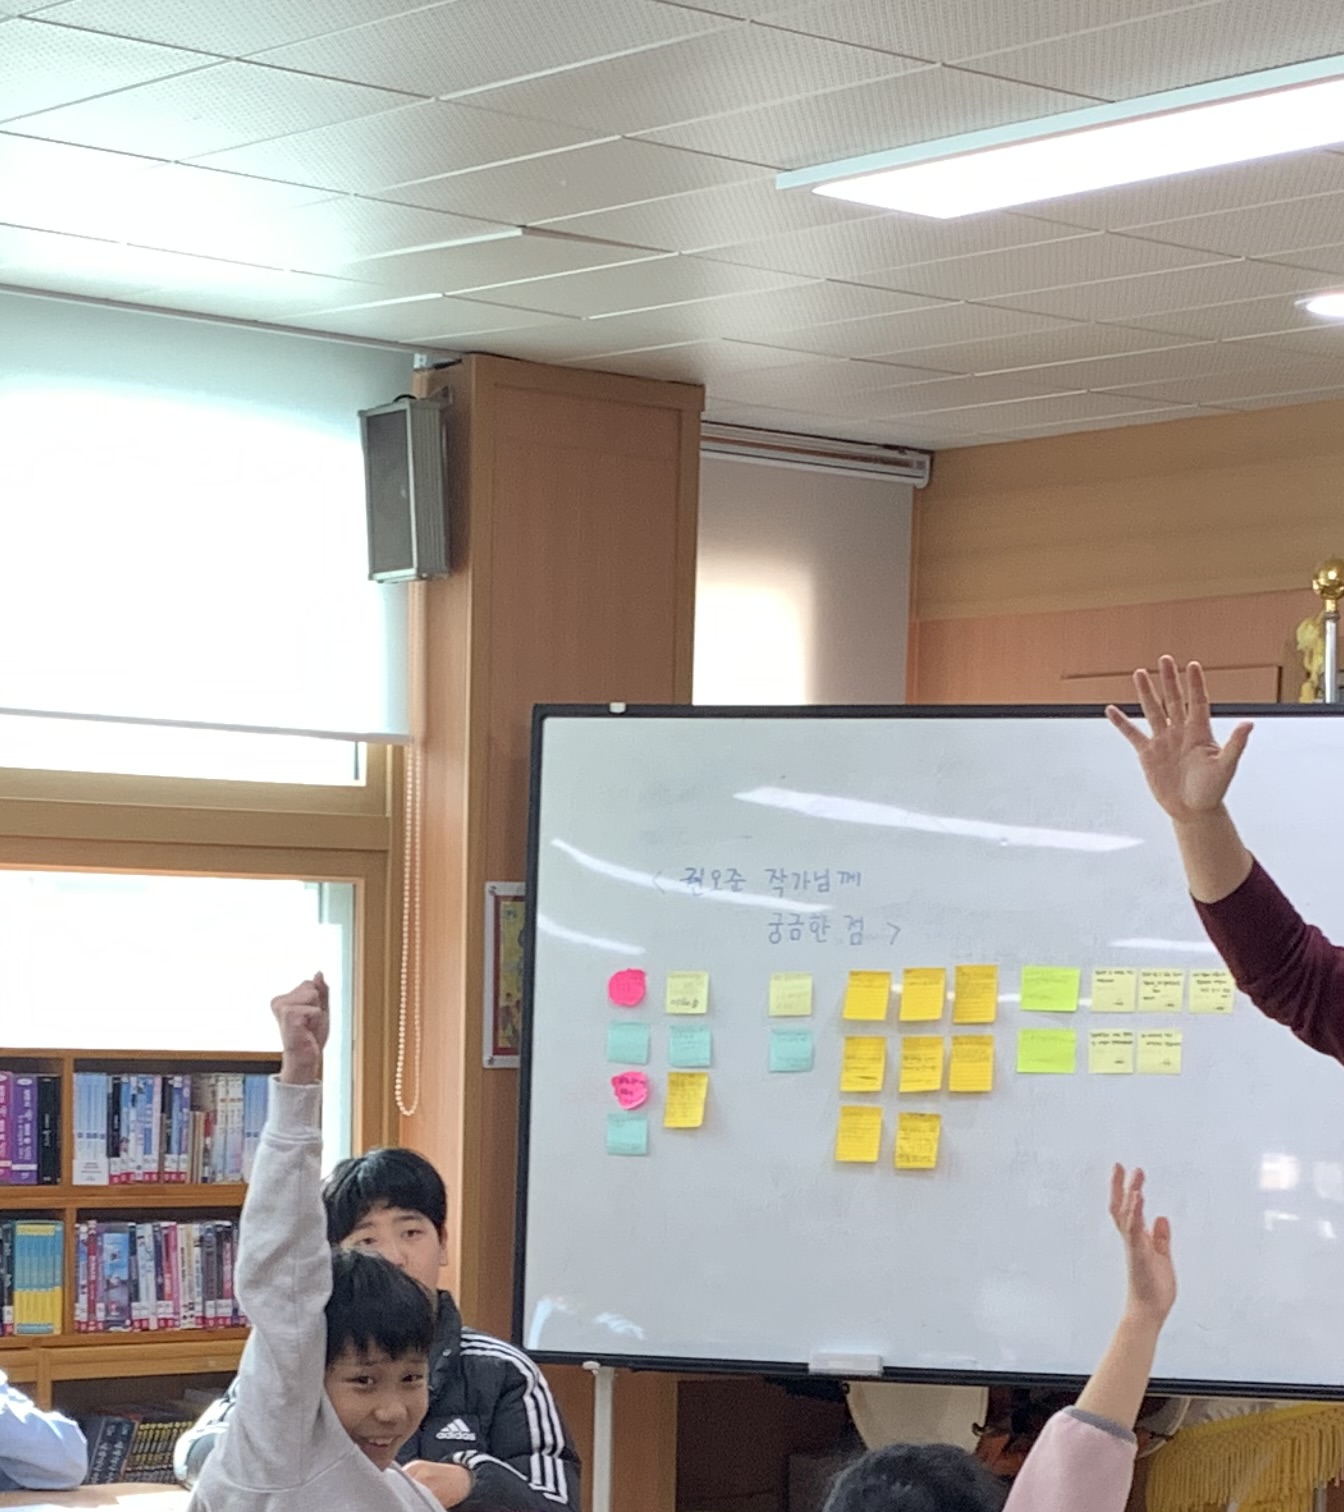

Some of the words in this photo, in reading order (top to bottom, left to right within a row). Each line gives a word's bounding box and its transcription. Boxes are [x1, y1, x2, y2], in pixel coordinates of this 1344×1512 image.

[765, 868, 862, 897] 작가님께
[768, 912, 832, 945] 궁금한
[844, 914, 865, 946] 점
[435, 1431, 476, 1441] adidas
